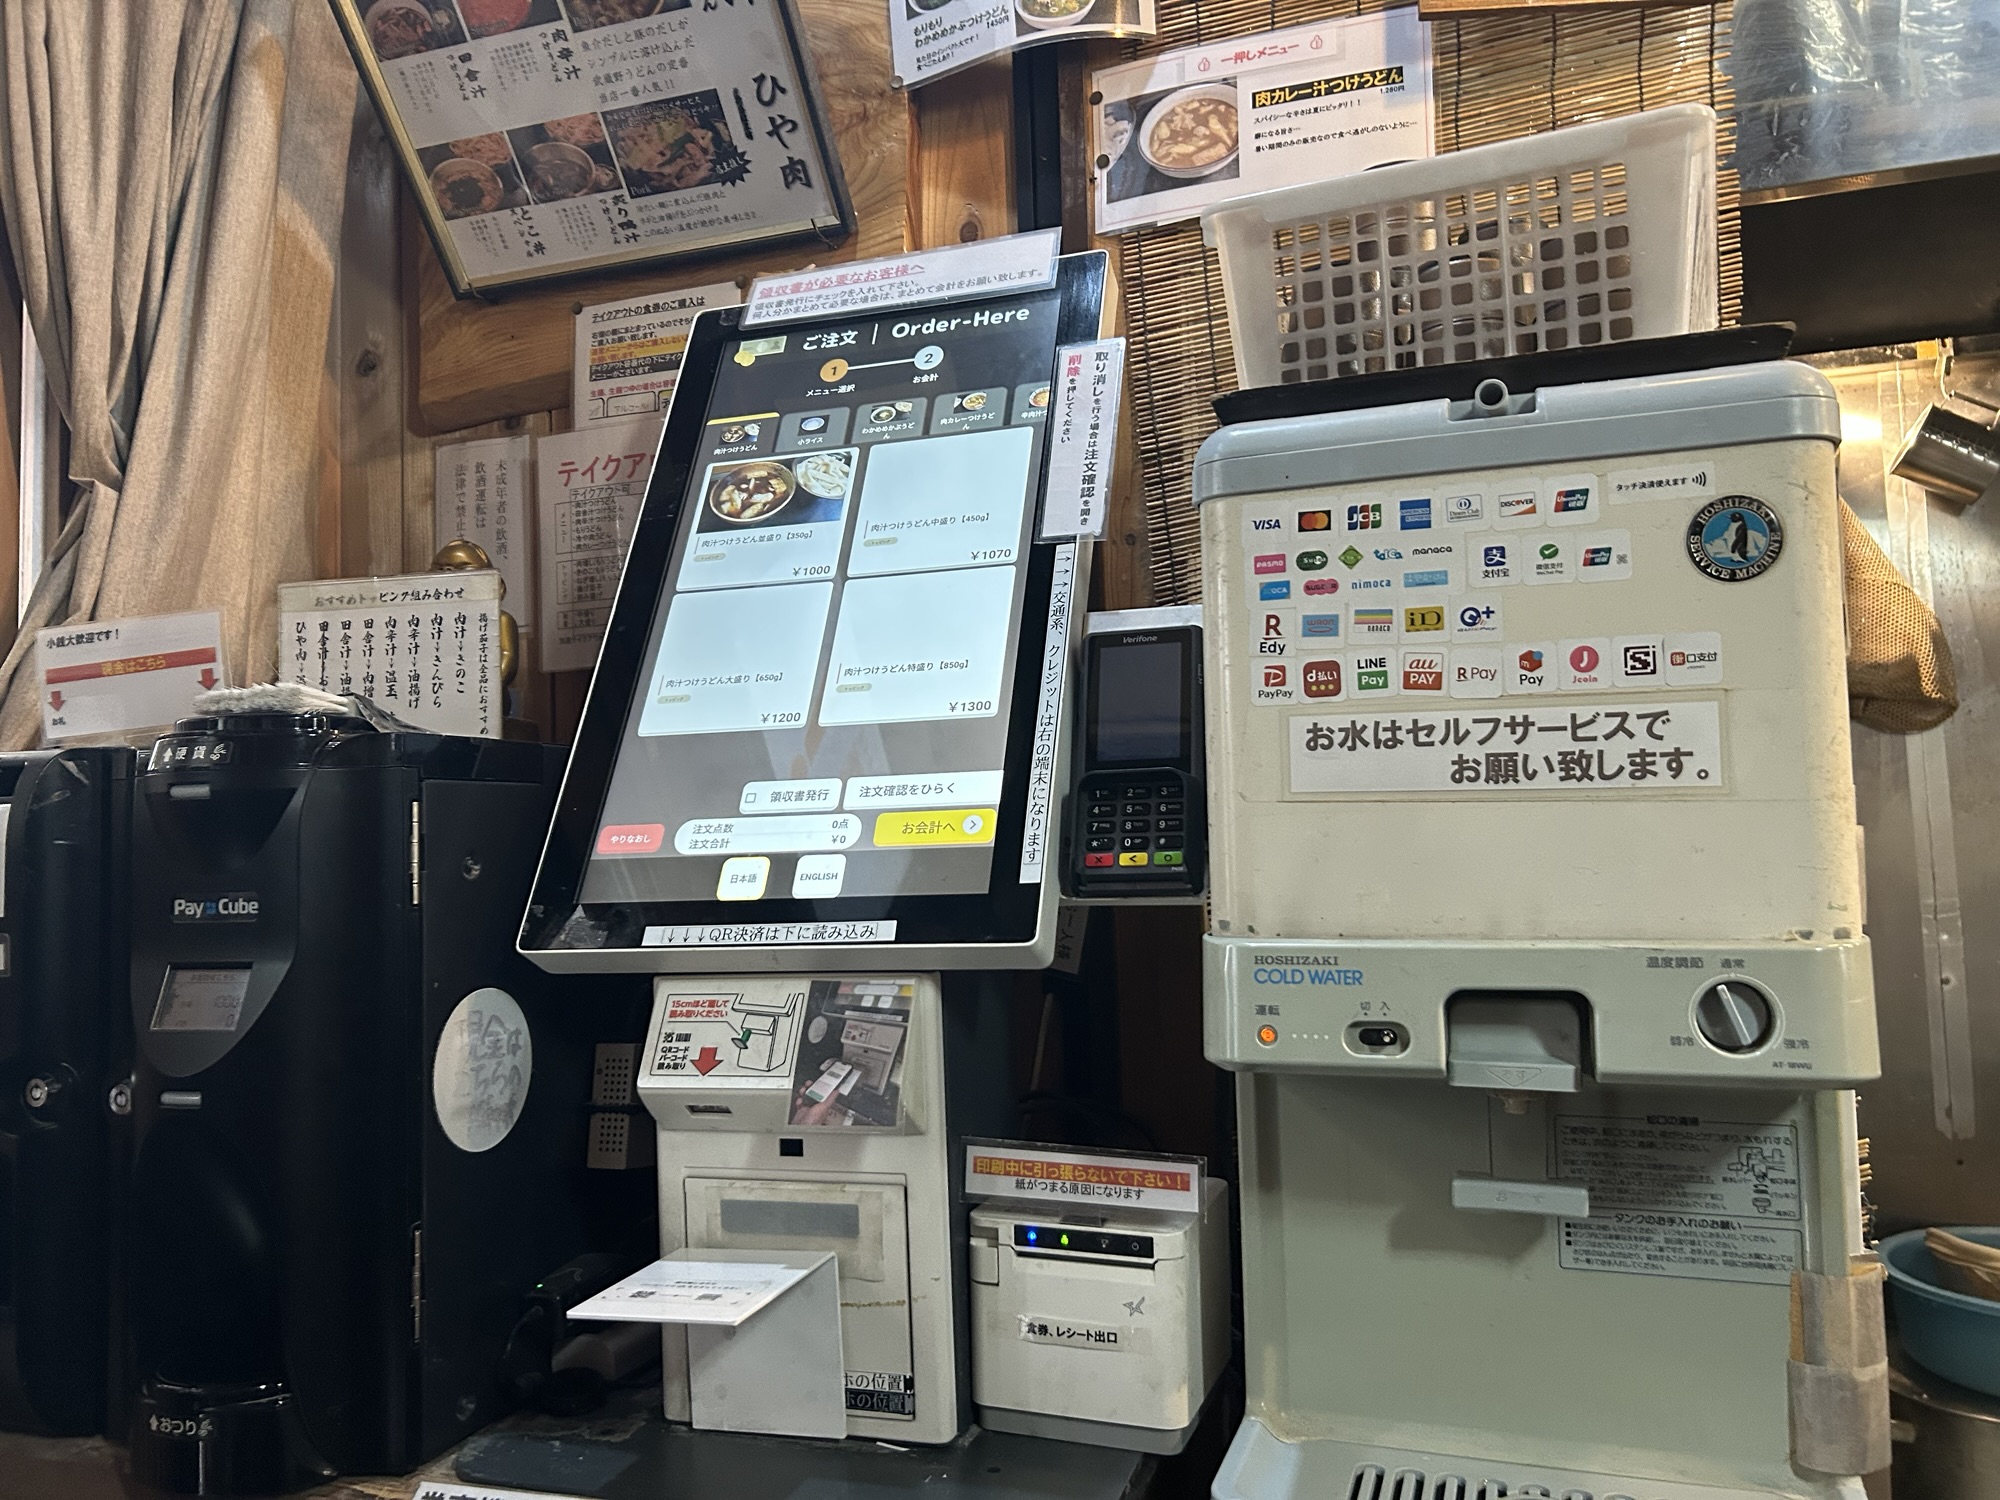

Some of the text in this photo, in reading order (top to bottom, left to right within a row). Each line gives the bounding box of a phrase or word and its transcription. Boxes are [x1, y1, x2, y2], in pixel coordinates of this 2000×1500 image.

[581, 17, 688, 52] 魚介だしと豚のだしが
[538, 31, 562, 83] つけうどん
[1220, 42, 1301, 65] 一押しメニュー
[446, 53, 470, 102] つけうどん
[458, 52, 487, 98] 田舎汁
[592, 56, 689, 87] 武蔵野うどんの定番
[1254, 67, 1404, 108] 肉カレー汁つけうどん
[759, 264, 925, 299] 領収書が必要なお客様へ
[752, 269, 1043, 319] 何人分かまとめて必要な場合は、まとめて会計をお願い致します。
[754, 280, 919, 311] 領収書発行にチェックを入れて下さい。
[592, 296, 705, 323] テイクアウトの食券のご購入は
[802, 307, 1030, 351] ご注文 Order-Here
[923, 352, 934, 364] 2
[830, 364, 839, 376] 1
[912, 372, 939, 385] お会計
[805, 383, 856, 397] メニュー選択
[1061, 354, 1082, 444] 削除を押してください
[940, 412, 996, 426] 肉カレーつけうど
[962, 423, 970, 431] ん
[797, 436, 823, 446] 小ライス
[1080, 351, 1109, 526] 取り消しを行う場合は注文確認を開き
[1616, 477, 1688, 491] タッチ決済使えます
[474, 461, 487, 528] 飲酒運転は
[495, 459, 508, 560] 未成年者の飲酒、
[1500, 498, 1534, 508] DISCOVER
[1348, 511, 1381, 523] JCB
[1697, 498, 1772, 526] HOSHIZAKI
[871, 512, 991, 533] 肉汁つけうどん中盛り【450g】
[1251, 519, 1281, 530] VISA
[701, 529, 814, 548] 肉汁つけうどん並盛り【350g】
[970, 548, 1012, 561] ¥1070
[1412, 546, 1453, 556] manaca
[1690, 531, 1781, 580] SERVICE MACHINE
[793, 565, 831, 577] ¥1000
[1256, 560, 1284, 568] PASMO
[1482, 568, 1510, 579] 支付宝
[1351, 579, 1391, 590] nimoca
[1265, 614, 1282, 636] R
[1409, 610, 1441, 627] iD
[46, 628, 119, 649] 小銭大歓迎です！
[1122, 635, 1158, 644] Verifone
[1259, 641, 1286, 655] Edy
[101, 655, 166, 676] 現金はこちら
[843, 659, 969, 678] 肉汁つけうどん特盛り【850g】
[1357, 657, 1386, 670] LINE
[1408, 658, 1437, 670] au
[478, 612, 489, 735] 揚げ茄子は全品におすすめ
[665, 672, 784, 688] 肉汁つけうどん大盛り【650g】
[1306, 669, 1337, 682] d払い
[1361, 674, 1385, 687] Pay
[1409, 674, 1436, 685] PAY
[1457, 666, 1497, 681] R Pay
[1519, 674, 1544, 687] Pay
[1258, 689, 1293, 699] PayPay
[948, 700, 992, 713] ¥1300
[761, 712, 801, 724] ¥1200
[1025, 591, 1066, 863] 交通系、クレジットは右の端末になります
[1305, 710, 1671, 751] お水はセルフサービスで
[174, 746, 207, 760] 硬貨
[1450, 747, 1710, 784] お願い致します。
[769, 788, 830, 804] 領収書発行
[858, 781, 957, 799] 注文確認をひらく
[1127, 788, 1133, 797] 2
[1161, 787, 1167, 795] 3
[1093, 806, 1099, 814] 4
[1126, 805, 1132, 813] 5
[1160, 803, 1166, 812] 6
[691, 818, 850, 836] 注文点数 0点
[901, 820, 957, 836] お会計へ
[1092, 823, 1098, 831] 7
[1125, 821, 1132, 830] 8
[1159, 820, 1166, 828] 9
[610, 833, 651, 845] やりなおし
[688, 834, 847, 851] 注文合計 ¥0
[1124, 837, 1131, 847] 0
[729, 872, 758, 885] 日本語
[799, 871, 839, 882] ENGLISH
[173, 897, 259, 918] Pay Cube
[709, 922, 877, 943] QR決済は下に読み込み
[1254, 955, 1339, 966] HOSHIZAKI
[1646, 956, 1704, 969] 温度調節
[1720, 958, 1745, 969] 通常
[1253, 968, 1363, 986] COLD WATER
[671, 999, 730, 1008] 15cmほど離して
[1255, 1004, 1280, 1017] 運転
[1380, 1001, 1391, 1011] 入
[668, 1009, 728, 1018] 読み取りください
[660, 1046, 690, 1054] QRコード
[658, 1054, 688, 1062] バーコード
[657, 1062, 686, 1071] 読み取り
[976, 1157, 1182, 1190] 印刷中に引っ張らないで下さい！
[1015, 1178, 1145, 1200] 紙がつまる原因になります
[1614, 1214, 1742, 1230] タンクのお手入れのお願い
[1026, 1322, 1118, 1344] 食券、レシート出口
[158, 1416, 197, 1434] おつり
